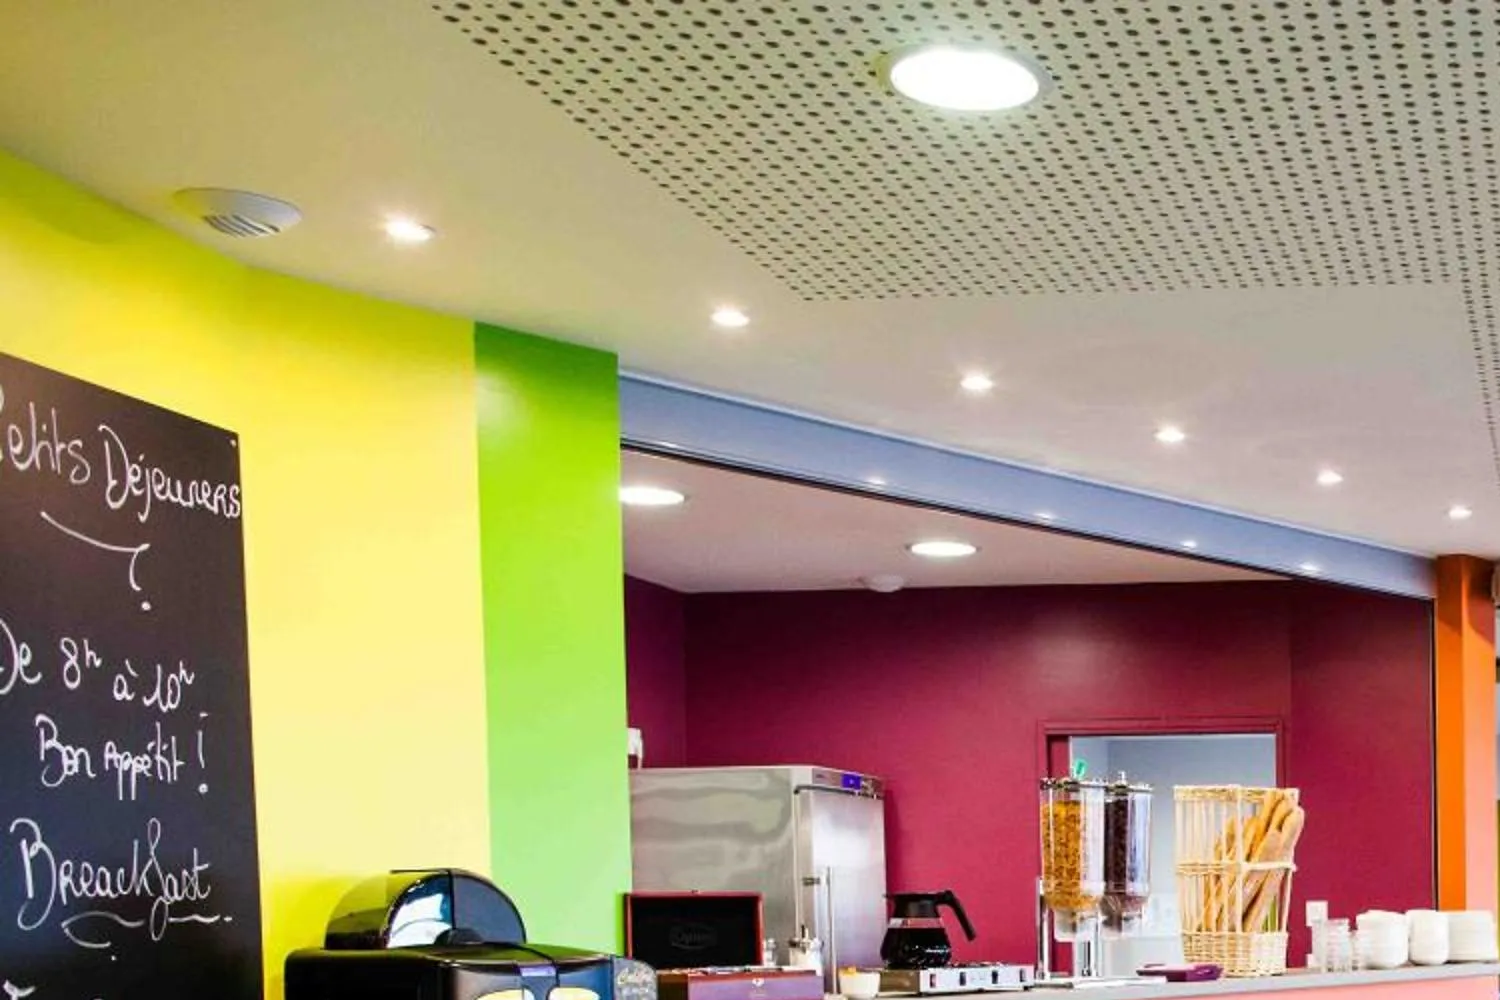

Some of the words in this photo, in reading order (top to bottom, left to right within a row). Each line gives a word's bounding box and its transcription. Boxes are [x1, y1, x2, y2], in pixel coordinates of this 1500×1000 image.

[0, 384, 91, 484] etits
[113, 659, 139, 700] à
[35, 713, 96, 787] Bon
